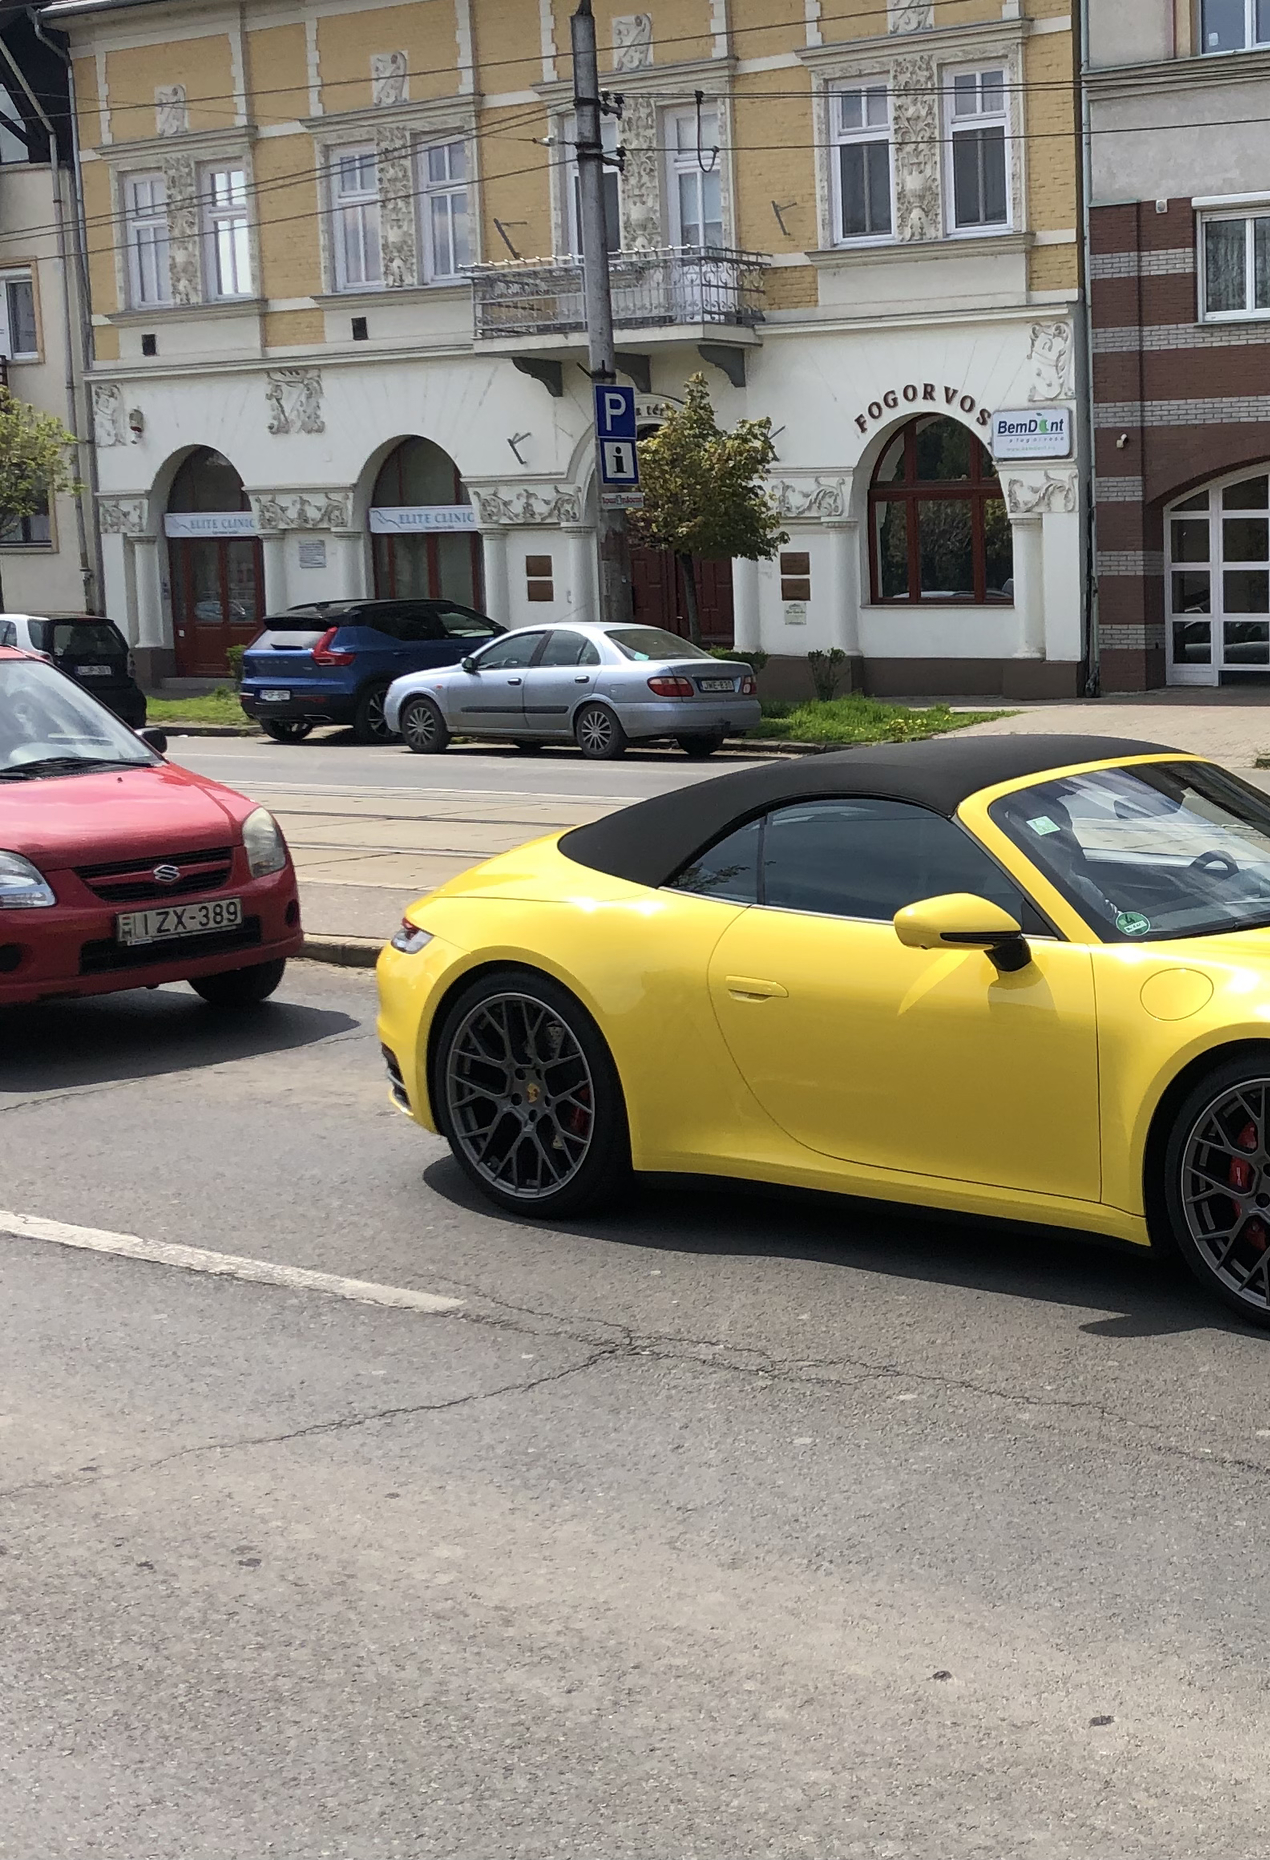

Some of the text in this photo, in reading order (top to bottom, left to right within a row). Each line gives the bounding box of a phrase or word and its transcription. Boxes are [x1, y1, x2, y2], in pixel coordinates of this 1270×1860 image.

[604, 392, 626, 431] P
[854, 383, 992, 434] FOGORVOS
[190, 518, 255, 529] ELITE CLINIC
[399, 512, 474, 524] ELITE CLINIC
